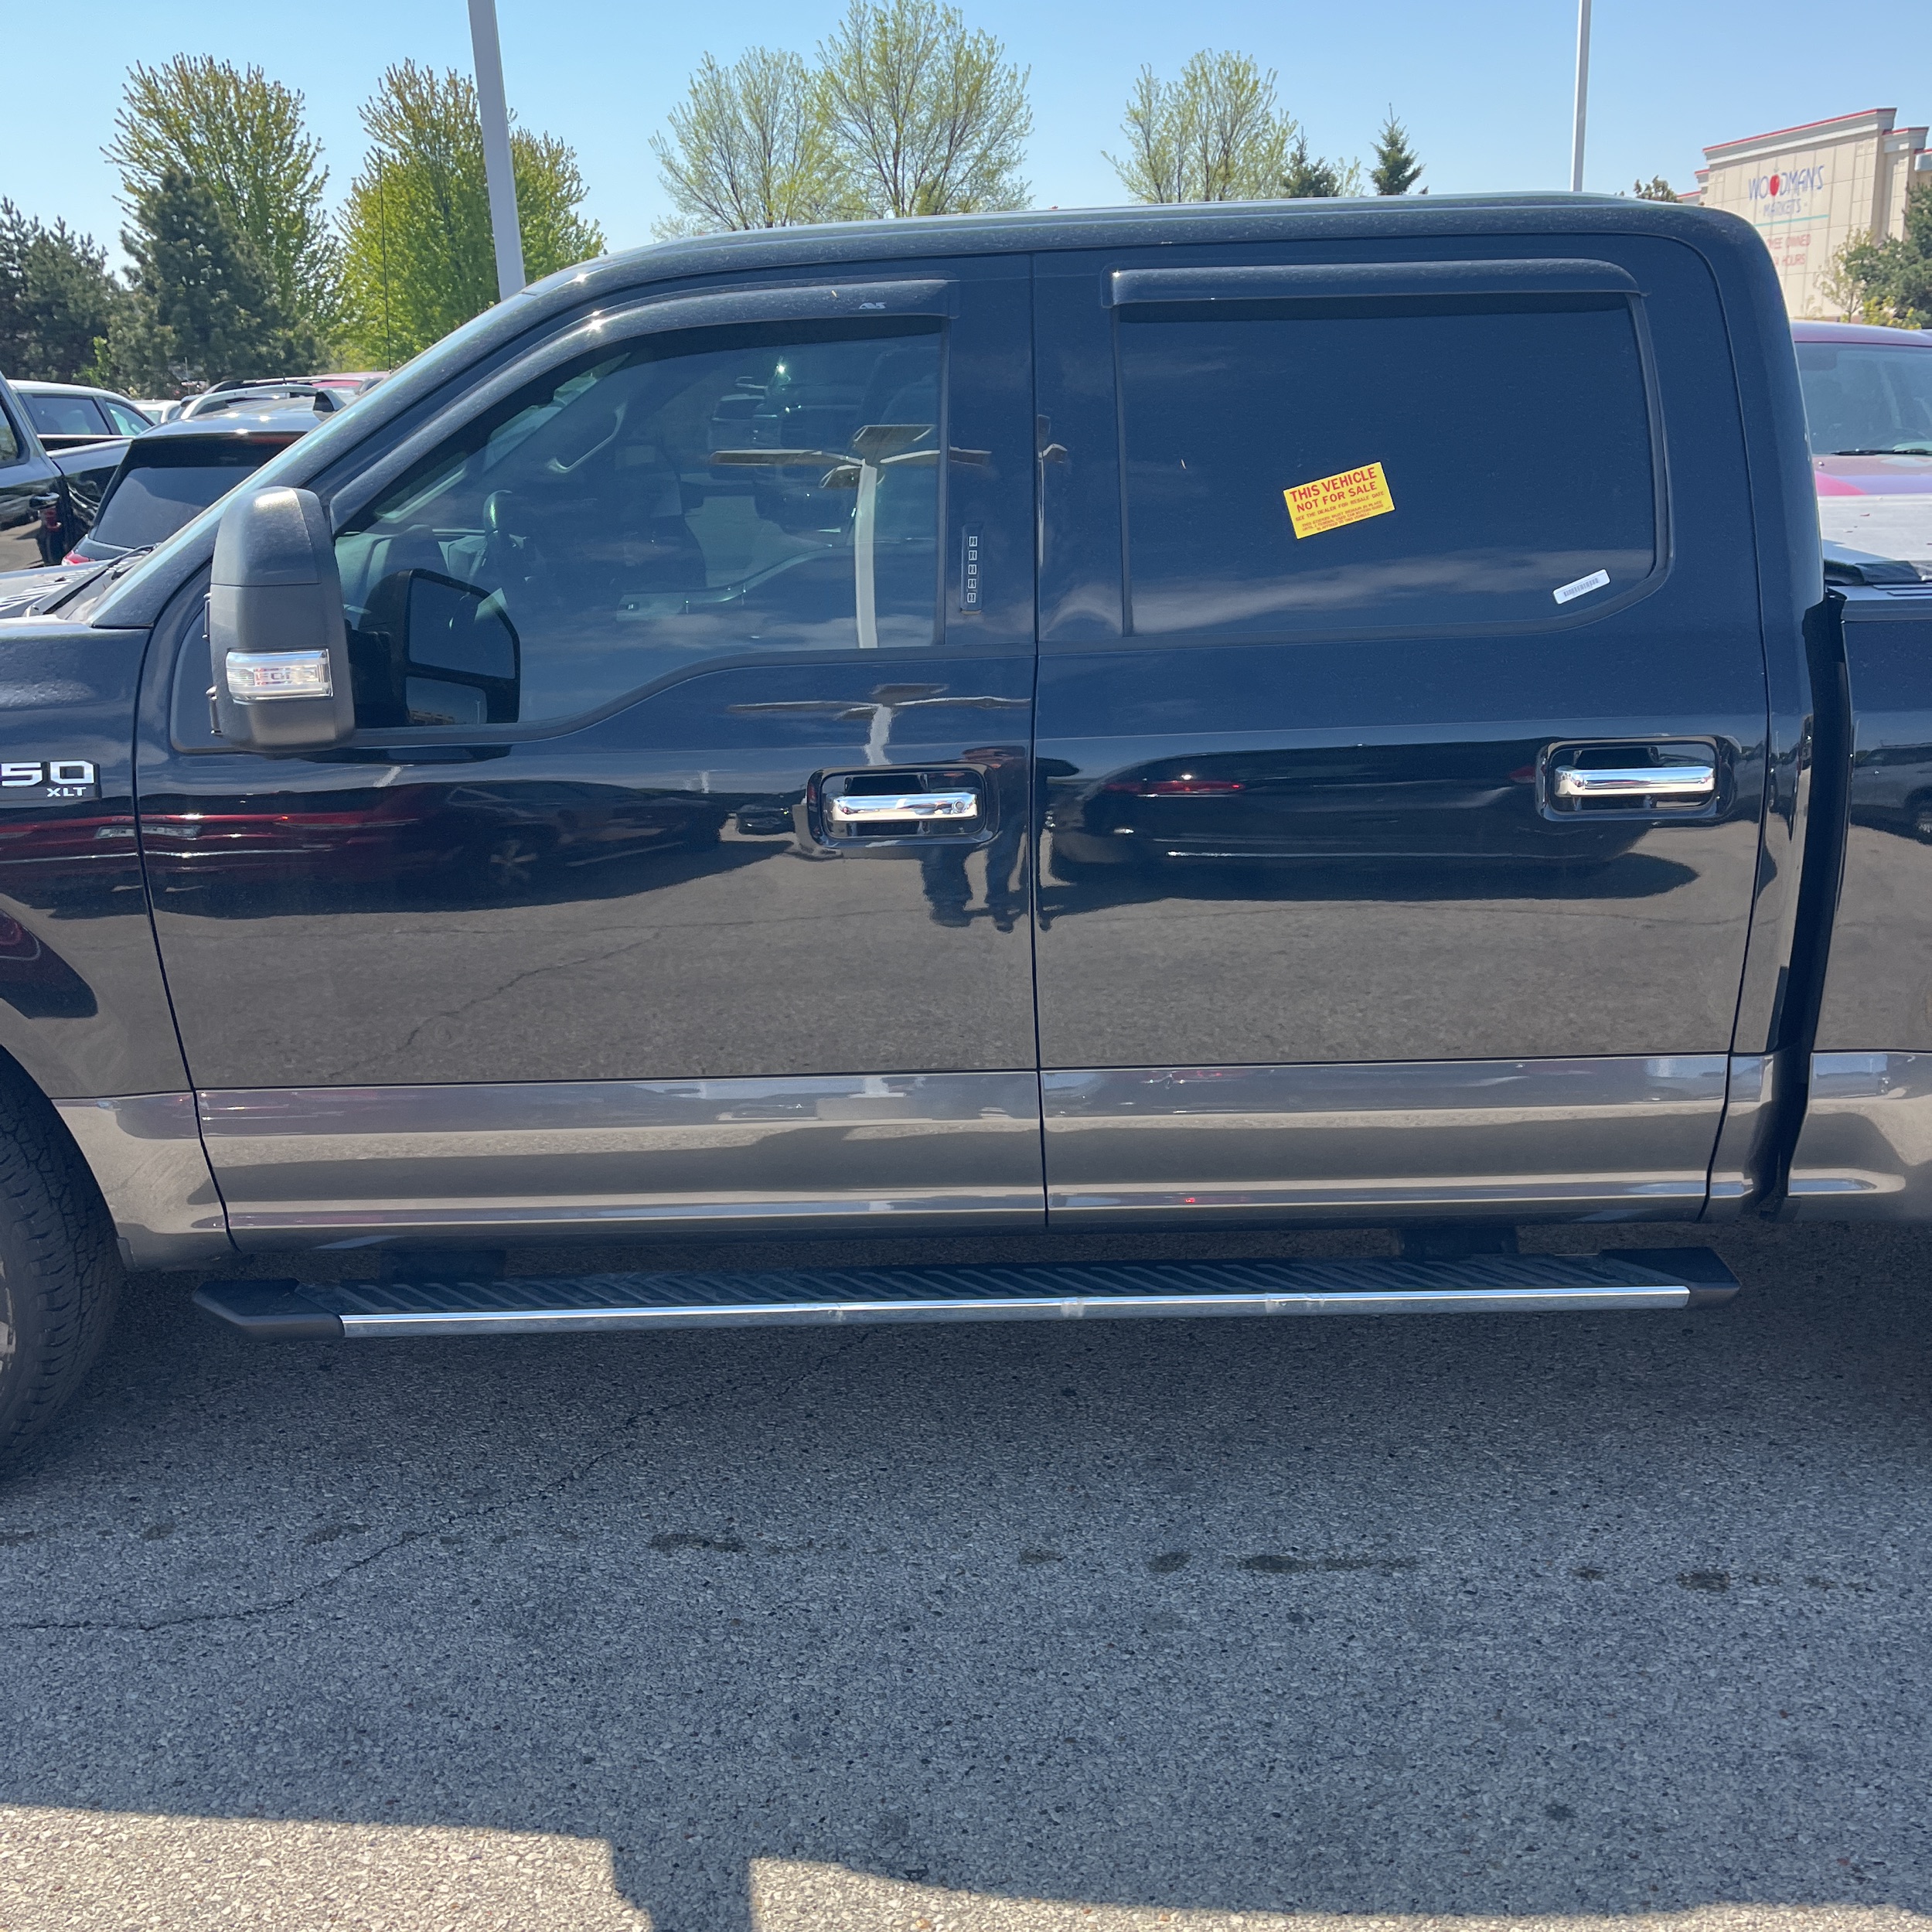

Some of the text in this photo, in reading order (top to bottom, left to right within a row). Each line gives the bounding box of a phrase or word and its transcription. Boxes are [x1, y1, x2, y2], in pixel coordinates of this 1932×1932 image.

[1290, 467, 1377, 502] THIS VEHICLE
[1297, 481, 1377, 513] NOT FOR SALE
[1317, 506, 1337, 515] DEALER
[1350, 496, 1369, 505] RESALE
[46, 787, 87, 797] XLT
